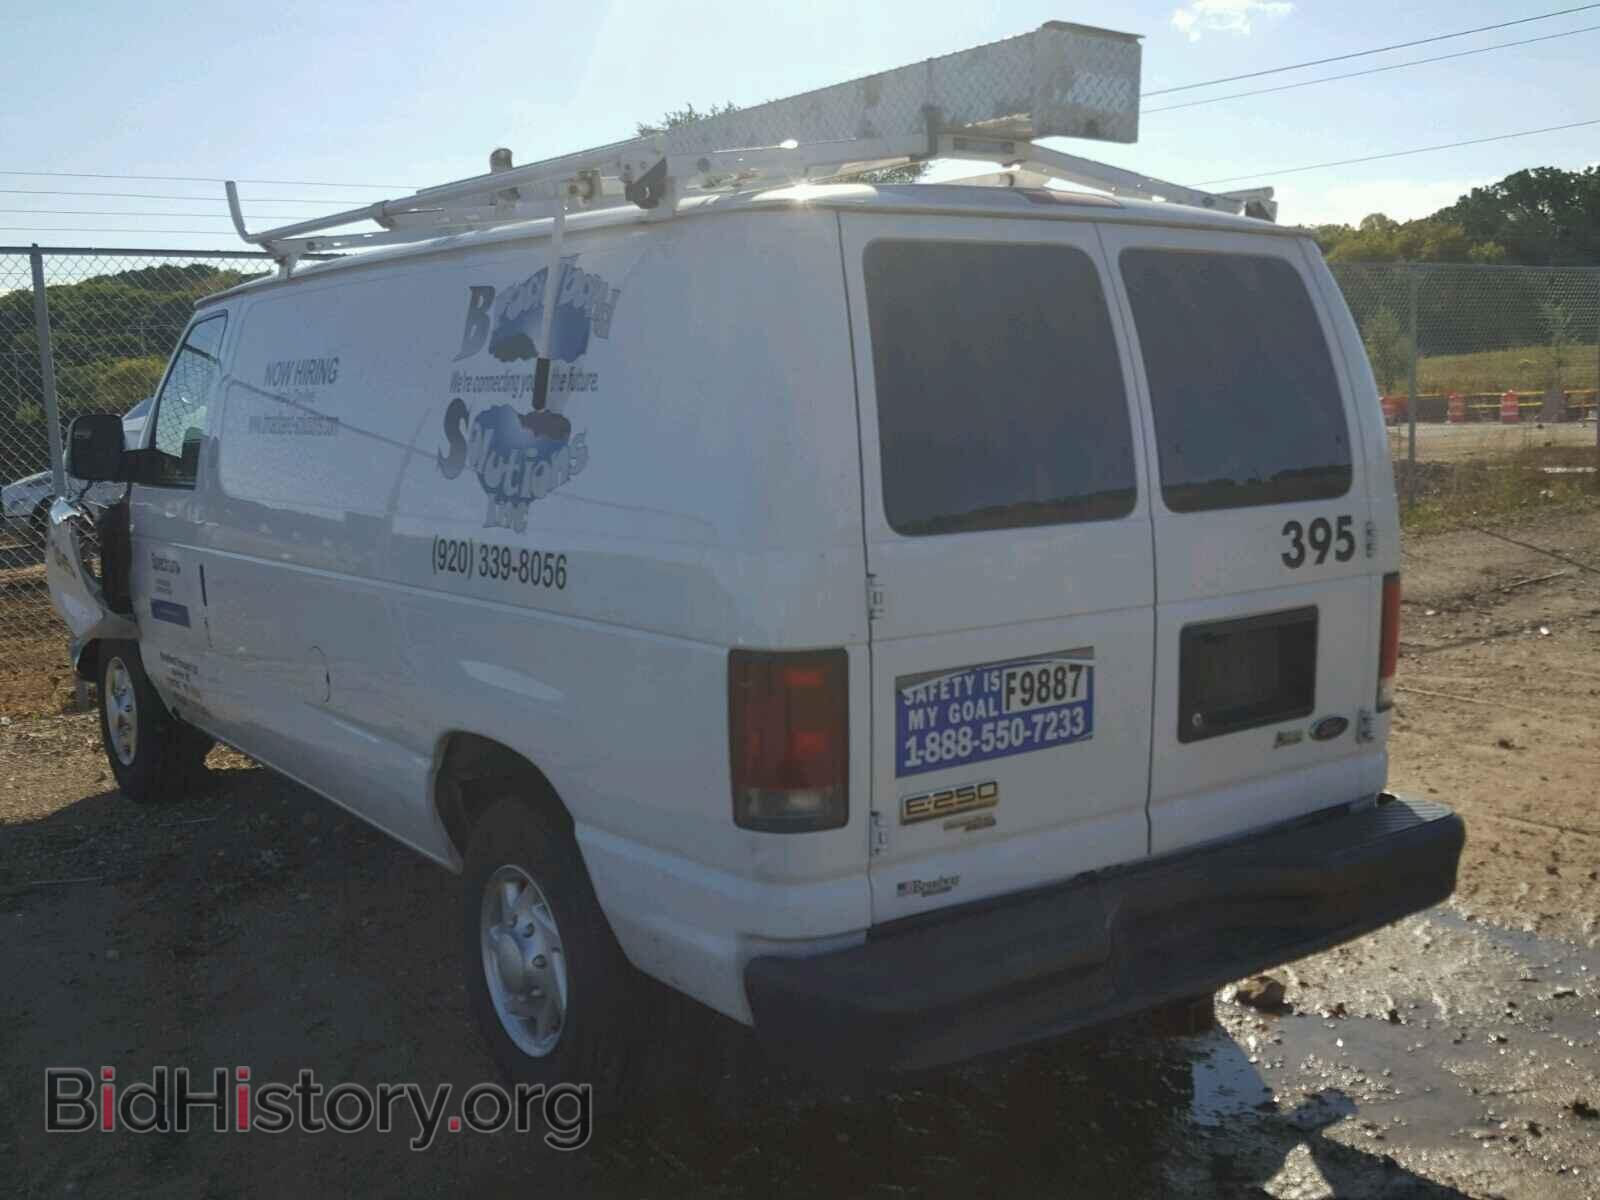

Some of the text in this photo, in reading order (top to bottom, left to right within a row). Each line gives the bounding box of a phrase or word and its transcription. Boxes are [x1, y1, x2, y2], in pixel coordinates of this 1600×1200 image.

[264, 355, 339, 387] NOW HIRING
[475, 370, 521, 398] connecting
[432, 534, 568, 590] (920) 339-8056
[1281, 514, 1356, 570] 395
[903, 668, 1000, 706] SAFETY IS
[1005, 664, 1085, 711] F9887
[908, 697, 1000, 732] MY GOAL
[904, 706, 1086, 768] 1-888-550-7233
